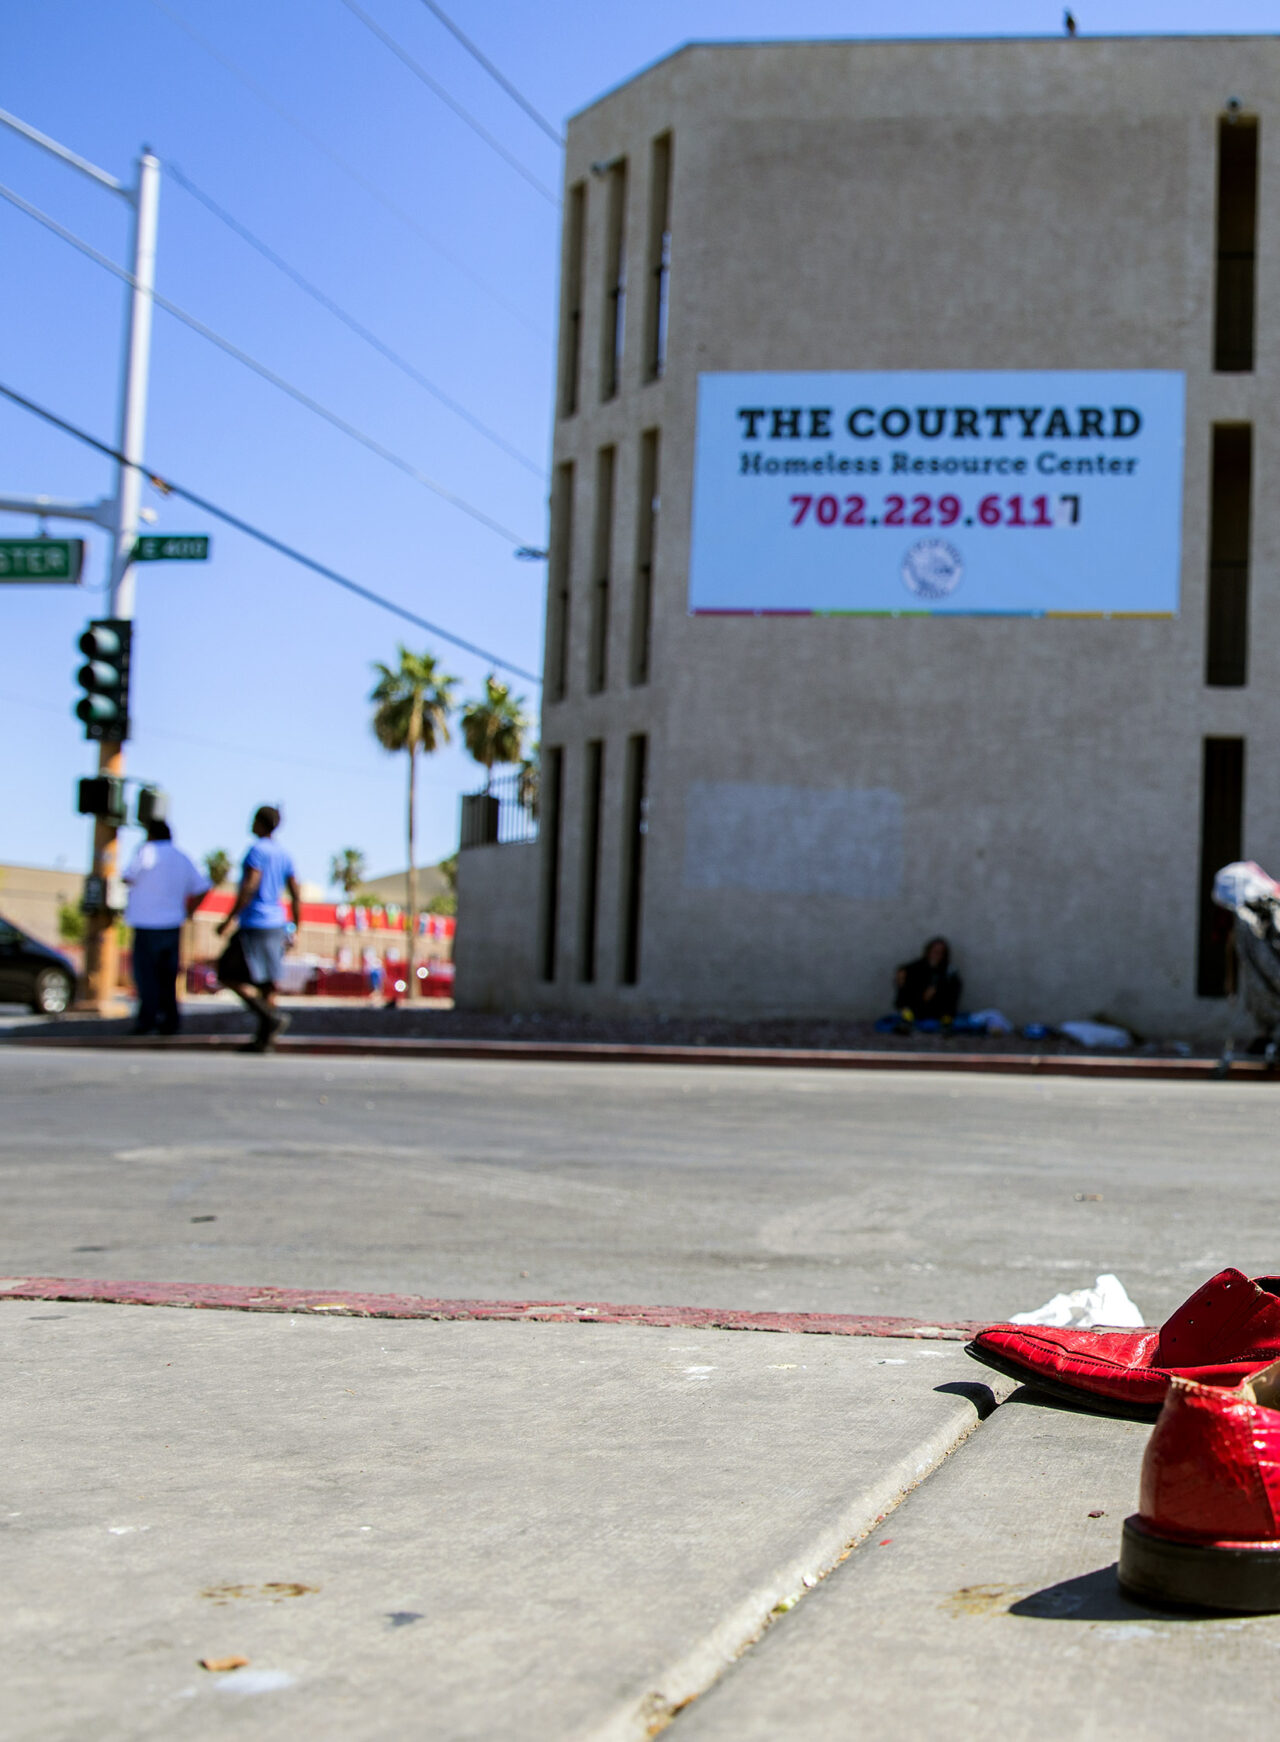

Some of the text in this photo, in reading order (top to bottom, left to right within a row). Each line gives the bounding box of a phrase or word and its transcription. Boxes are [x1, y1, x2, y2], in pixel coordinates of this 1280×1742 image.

[737, 407, 1142, 439] THE COURTYARD
[739, 451, 1138, 476] Homeless Resource Center
[790, 494, 1080, 527] 702.229.6117
